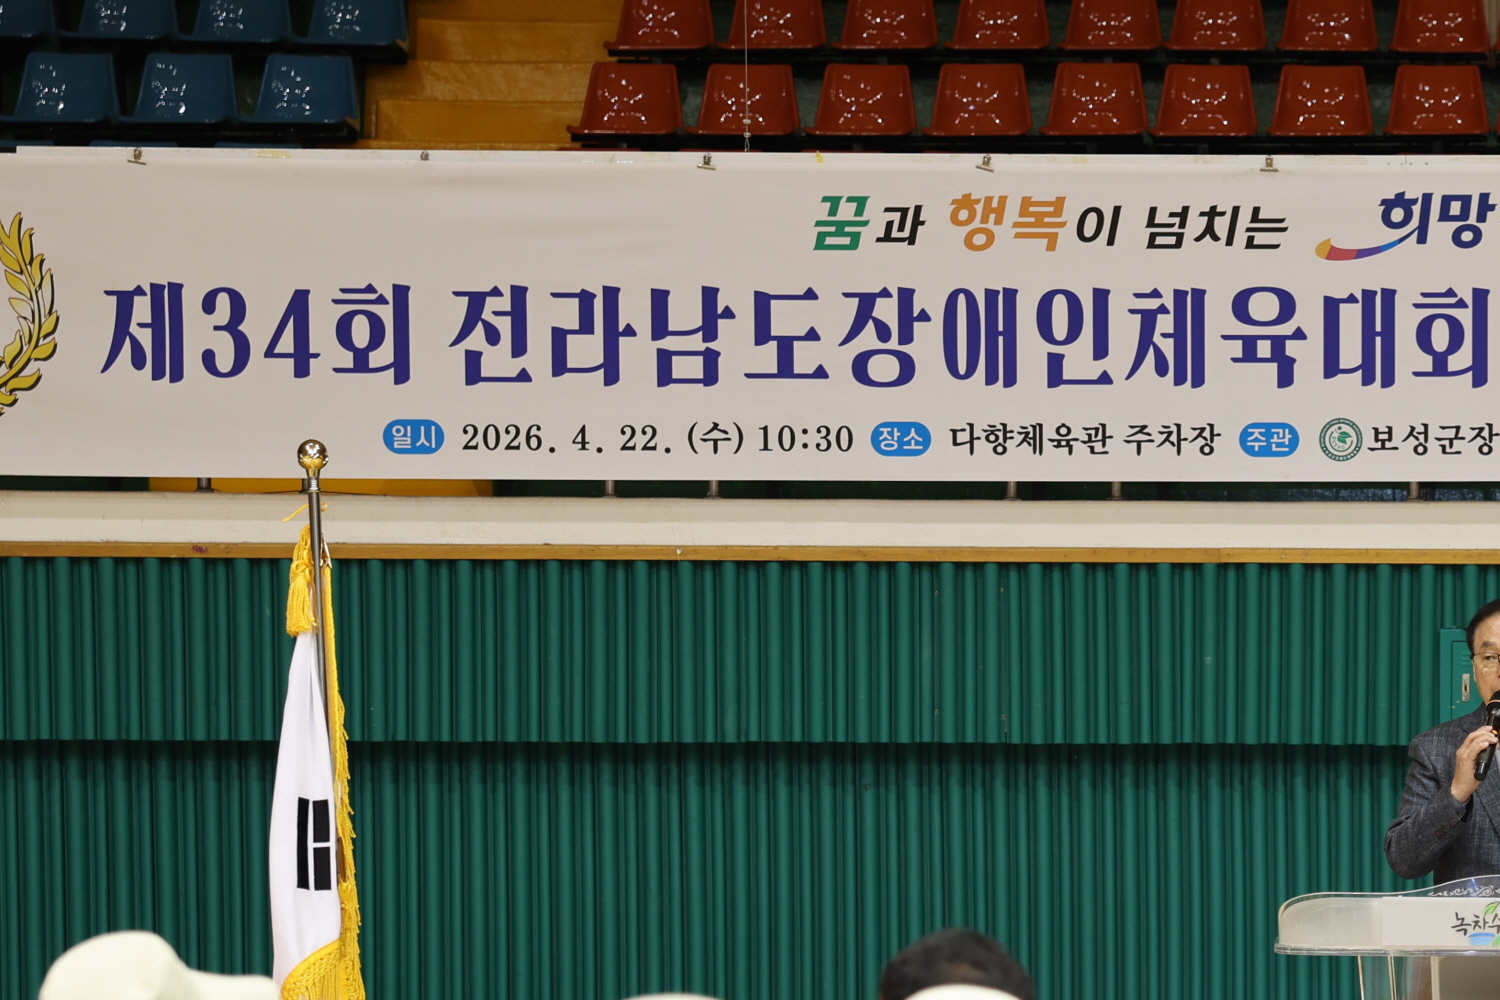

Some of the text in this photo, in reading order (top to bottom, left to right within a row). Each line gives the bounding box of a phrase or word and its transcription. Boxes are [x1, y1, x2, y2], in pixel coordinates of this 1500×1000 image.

[814, 196, 927, 252] 꿈과
[950, 193, 1122, 253] 행복이
[1145, 205, 1290, 251] 넘치는
[101, 281, 412, 386] 제34회
[449, 283, 1491, 389] 전라남도장애인체육대회
[391, 424, 437, 449] 일시
[462, 424, 557, 455] 2026.
[572, 425, 605, 455] 4.
[620, 425, 673, 455] 22.
[687, 422, 745, 456] (수)
[759, 425, 855, 454] 10:30
[878, 427, 924, 451] 장소
[949, 423, 1115, 457] 다향체육관
[1124, 423, 1223, 458] 주차장
[1246, 428, 1292, 452] 주관
